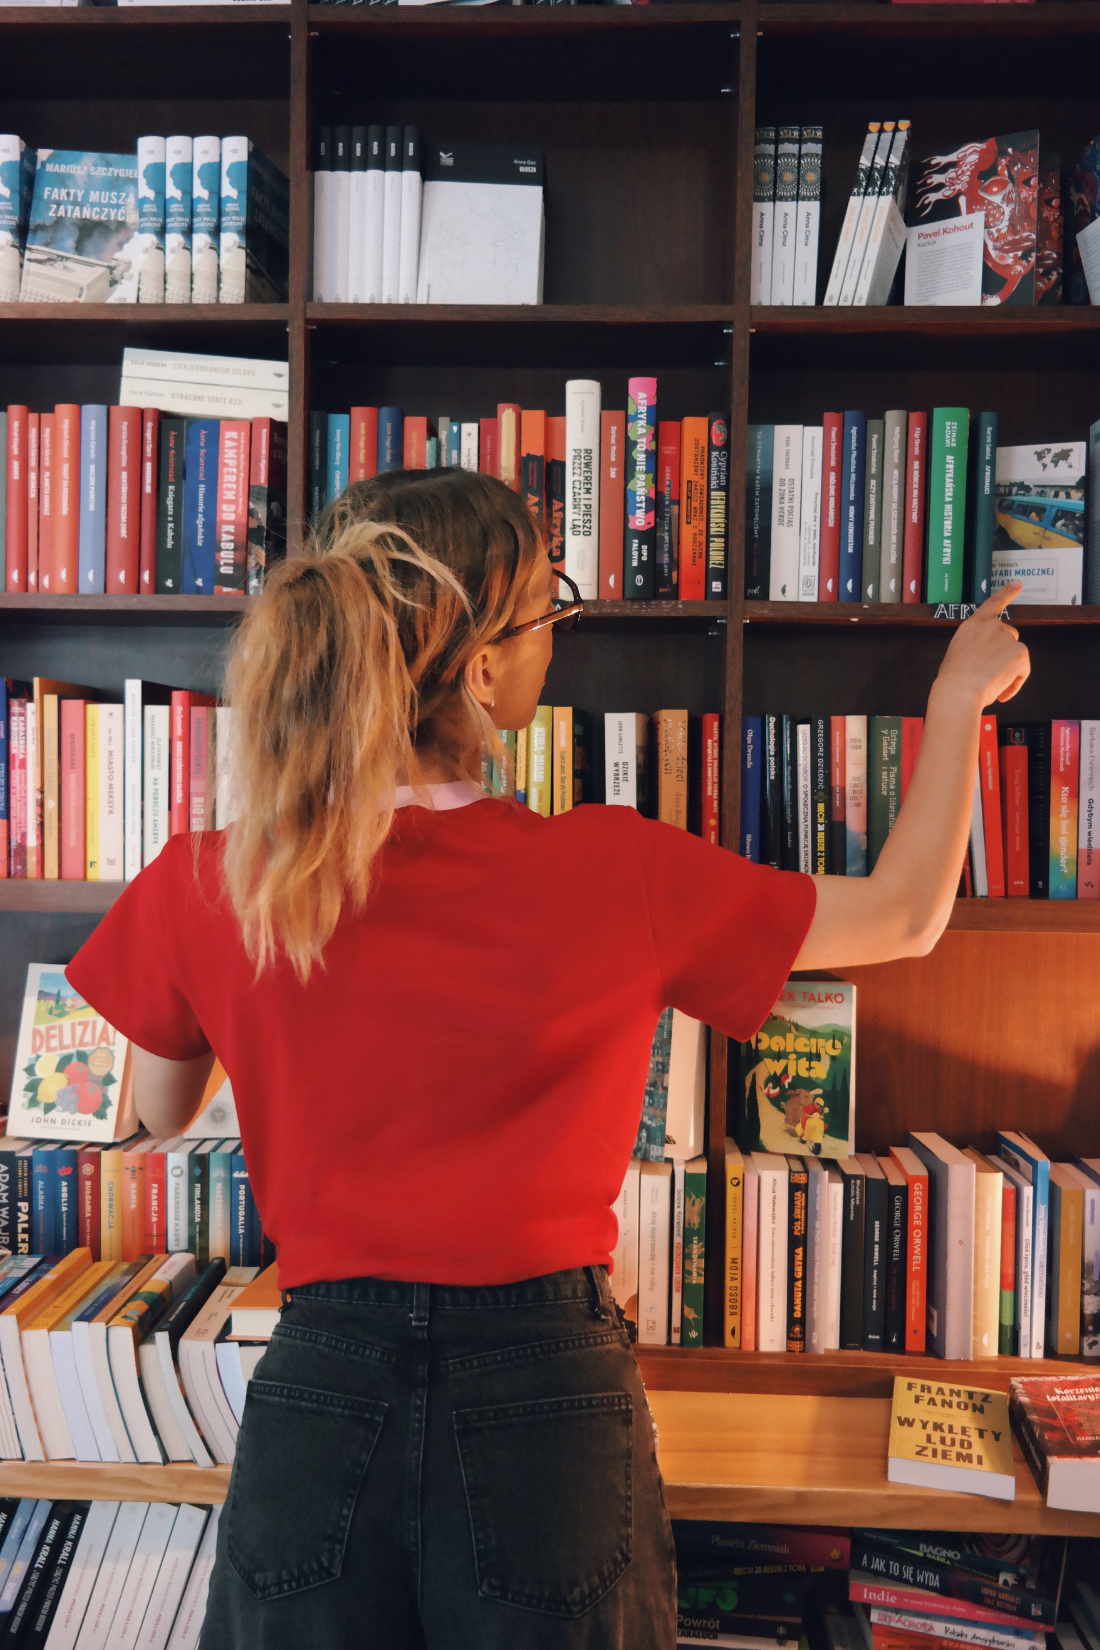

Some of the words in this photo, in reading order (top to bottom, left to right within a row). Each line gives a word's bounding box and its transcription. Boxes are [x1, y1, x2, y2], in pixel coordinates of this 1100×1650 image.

[46, 163, 87, 175] MARIUSZ
[44, 187, 84, 203] FAKTY
[90, 190, 135, 206] MUSZĄ
[49, 203, 126, 221] ZATAŃCZYĆ
[917, 229, 940, 241] Pavel
[942, 221, 974, 235] Kohout
[637, 392, 647, 433] AFRYKA
[637, 438, 646, 451] TO
[222, 431, 238, 499] KAMPEREM
[573, 449, 581, 477] PRZEZ
[583, 449, 592, 495] ROWEREM
[637, 454, 646, 471] NIE
[710, 451, 719, 489] Kosiński
[719, 451, 727, 485] Cyprian
[944, 455, 956, 501] AFRYKAŃSKA
[572, 480, 581, 516] CZARNY
[636, 474, 649, 526] PAŃSTWO
[221, 503, 237, 520] DO
[583, 504, 592, 536] PIESZO
[710, 491, 727, 535] AFRYKAŃSKI
[786, 506, 794, 528] POCIĄG
[943, 504, 952, 537] HISTORIA
[167, 523, 175, 549] Kabulu
[550, 499, 563, 557] Afryka
[570, 519, 582, 536] LĄD
[220, 524, 236, 575] KABULU
[710, 538, 725, 568] POLONEZ
[943, 539, 951, 564] AFRYKI
[991, 569, 1012, 577] AFARI
[1014, 567, 1054, 577] MROCZNEJ
[933, 603, 1011, 621] AFRA
[890, 730, 898, 754] Ortega
[153, 778, 158, 786] NA
[1061, 786, 1069, 803] Kto
[193, 797, 204, 814] RIO
[817, 803, 825, 822] NIECH
[1059, 805, 1069, 817] się
[1086, 798, 1094, 829] Gdybym
[1060, 820, 1069, 834] boi
[817, 832, 825, 852] BĘDZIE
[1059, 835, 1068, 873] gender?
[1086, 831, 1094, 865] wiedziała
[801, 991, 845, 1004] TALKO
[31, 1019, 117, 1054] DELIZIA!
[763, 1053, 827, 1079] wita
[30, 1116, 57, 1125] JOHN
[61, 1117, 92, 1127] DICKIE
[0, 1163, 9, 1203] ADAM
[792, 1191, 801, 1218] ŚWIATA
[894, 1195, 902, 1227] GEORGE
[913, 1183, 922, 1226] GEORGE
[17, 1201, 29, 1254] PALER
[892, 1230, 901, 1261] ORWELL
[912, 1229, 921, 1271] ORWELL
[729, 1258, 738, 1282] MOJA
[794, 1247, 803, 1278] GRYKA
[729, 1286, 738, 1316] OSOBA
[794, 1280, 802, 1318] DANUTA
[907, 1381, 993, 1404] FRANTZ
[913, 1394, 985, 1415] FANON
[1046, 1393, 1100, 1401] totalitaryz
[897, 1415, 1003, 1442] WYKLĘTY
[925, 1433, 973, 1450] LUD
[914, 1444, 984, 1466] ZIEMI
[45, 1519, 60, 1544] HANNA
[67, 1513, 82, 1539] HANNA
[35, 1544, 51, 1569] KRALL
[57, 1540, 74, 1565] KRALL
[711, 1534, 745, 1549] Planeta
[747, 1539, 790, 1554] Ziemniak
[919, 1543, 961, 1560] BAGNO
[861, 1554, 868, 1567] A
[870, 1556, 886, 1573] JAK
[889, 1560, 900, 1575] TO
[902, 1563, 914, 1583] SIĘ
[916, 1567, 940, 1588] WYDA
[862, 1587, 898, 1604] Indie
